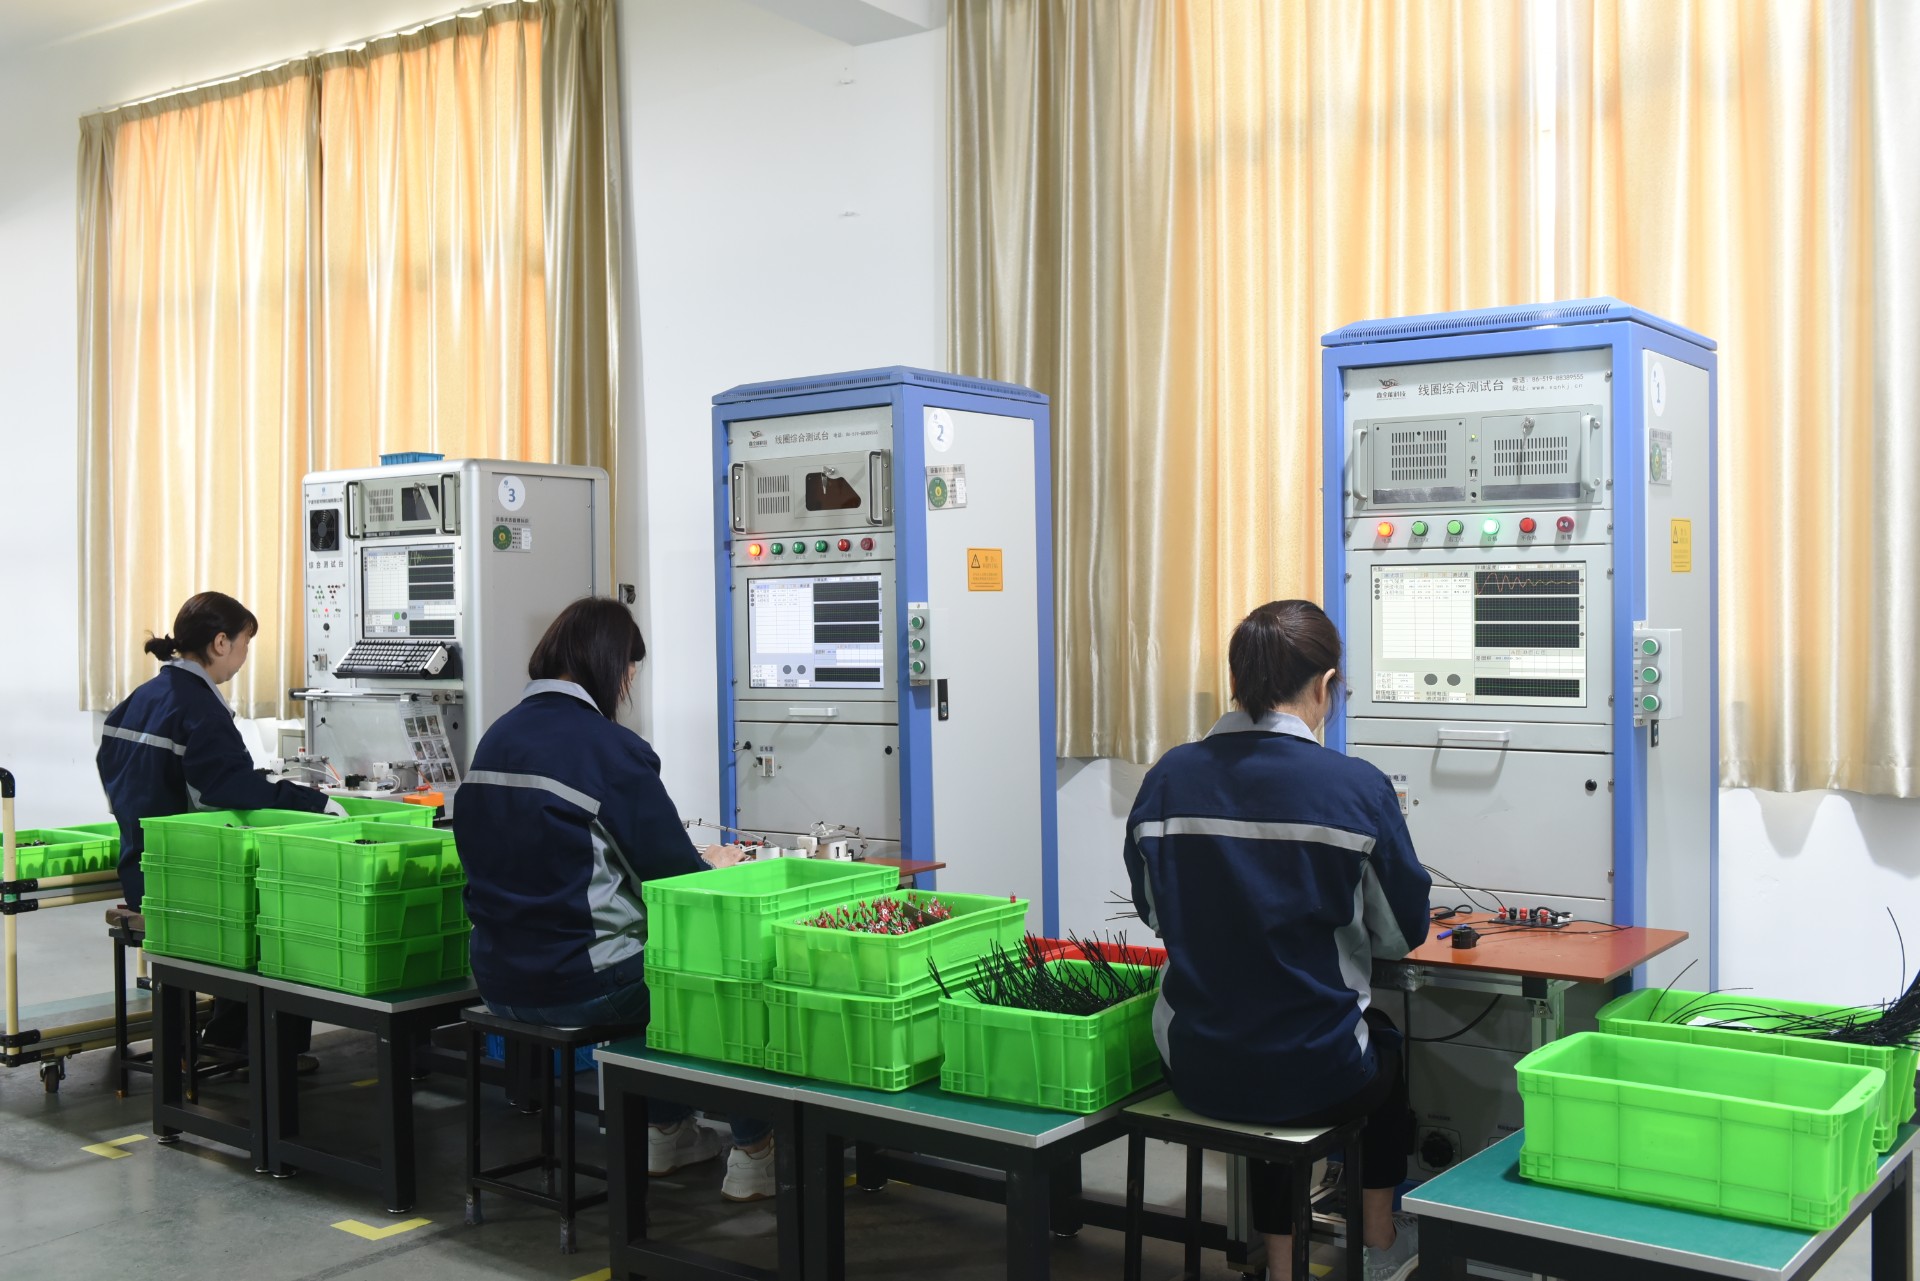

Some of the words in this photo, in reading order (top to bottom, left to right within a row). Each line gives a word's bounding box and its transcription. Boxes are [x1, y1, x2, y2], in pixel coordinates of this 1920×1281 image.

[1418, 379, 1504, 396] 线圈综合测试台
[1656, 382, 1661, 403] 1
[775, 430, 829, 445] 线圈综合测试台
[937, 424, 944, 442] 2
[508, 488, 516, 503] 3
[308, 560, 344, 569] 综合测试台
